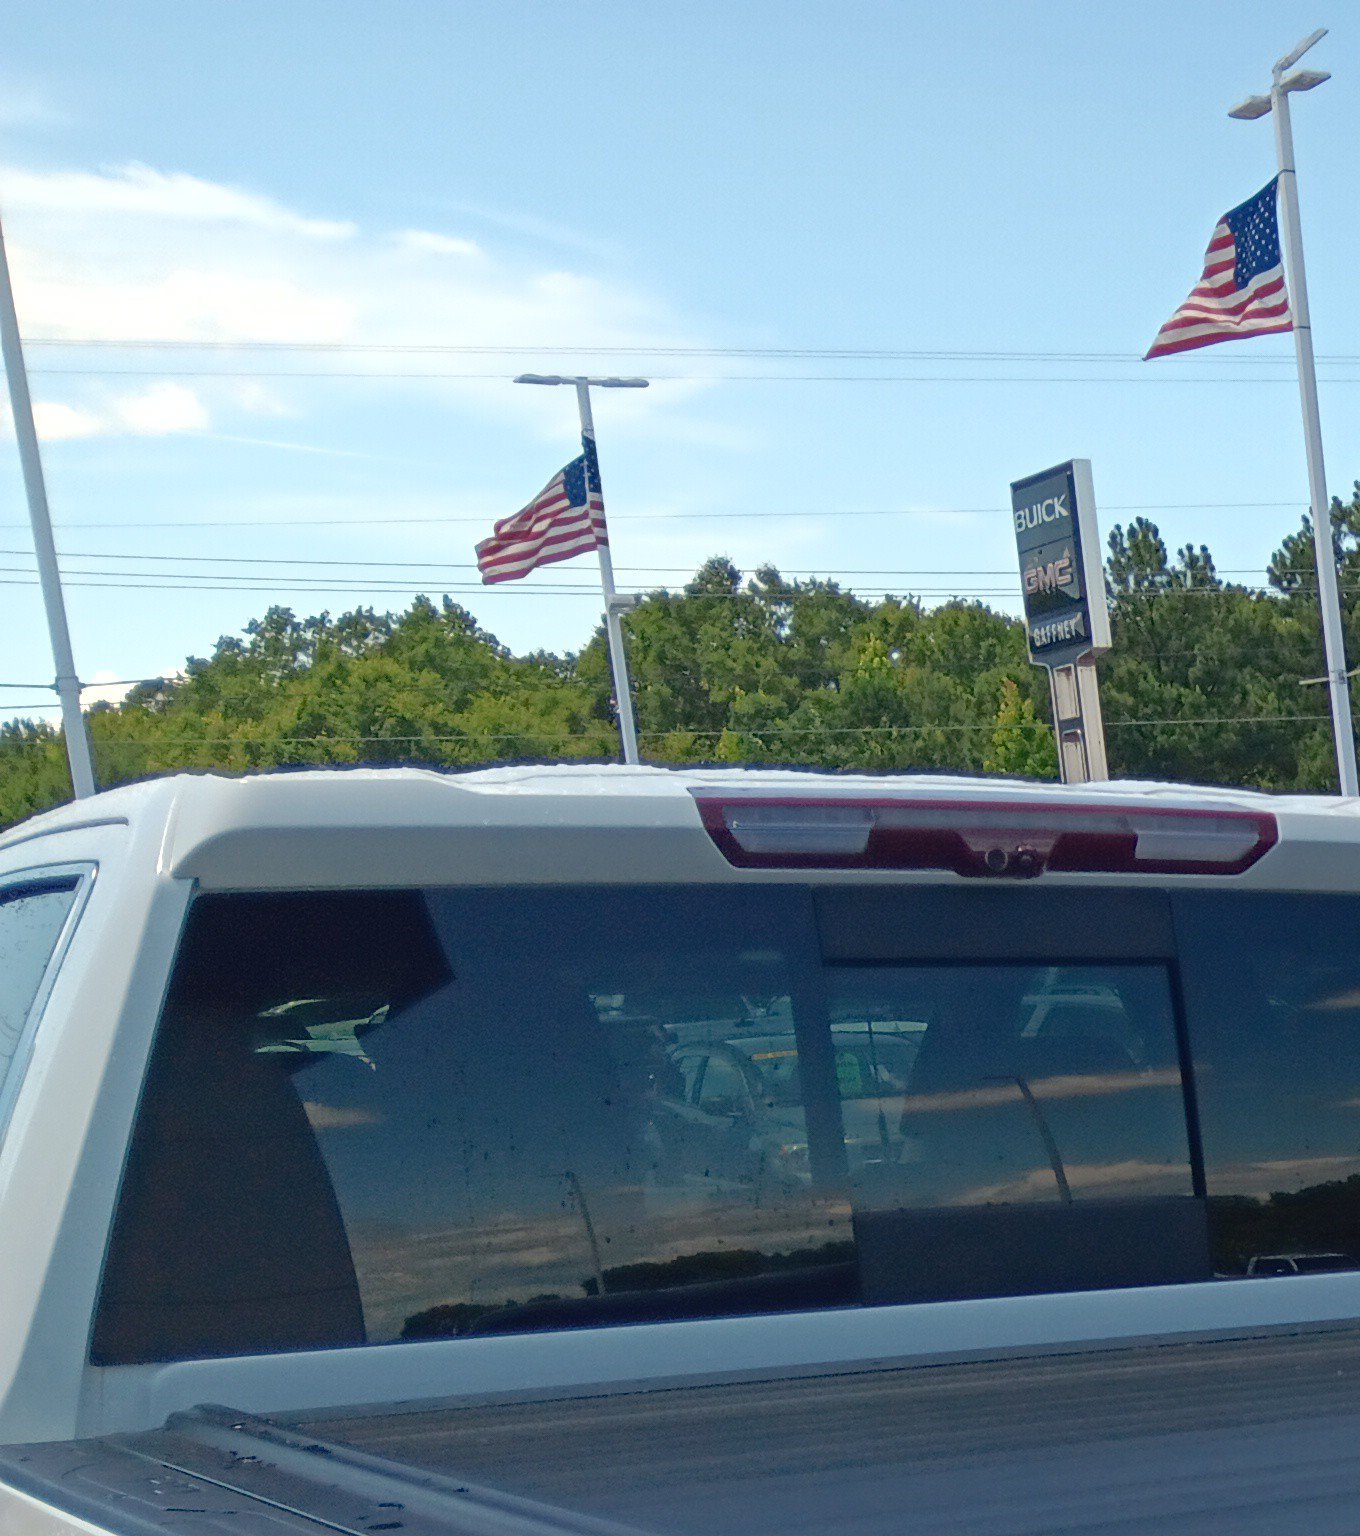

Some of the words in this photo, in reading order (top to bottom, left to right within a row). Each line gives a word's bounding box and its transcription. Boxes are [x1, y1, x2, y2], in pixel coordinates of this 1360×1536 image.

[1015, 494, 1069, 532] BUICK
[1024, 557, 1073, 595] GMC
[1033, 617, 1077, 647] GAFFNEY
